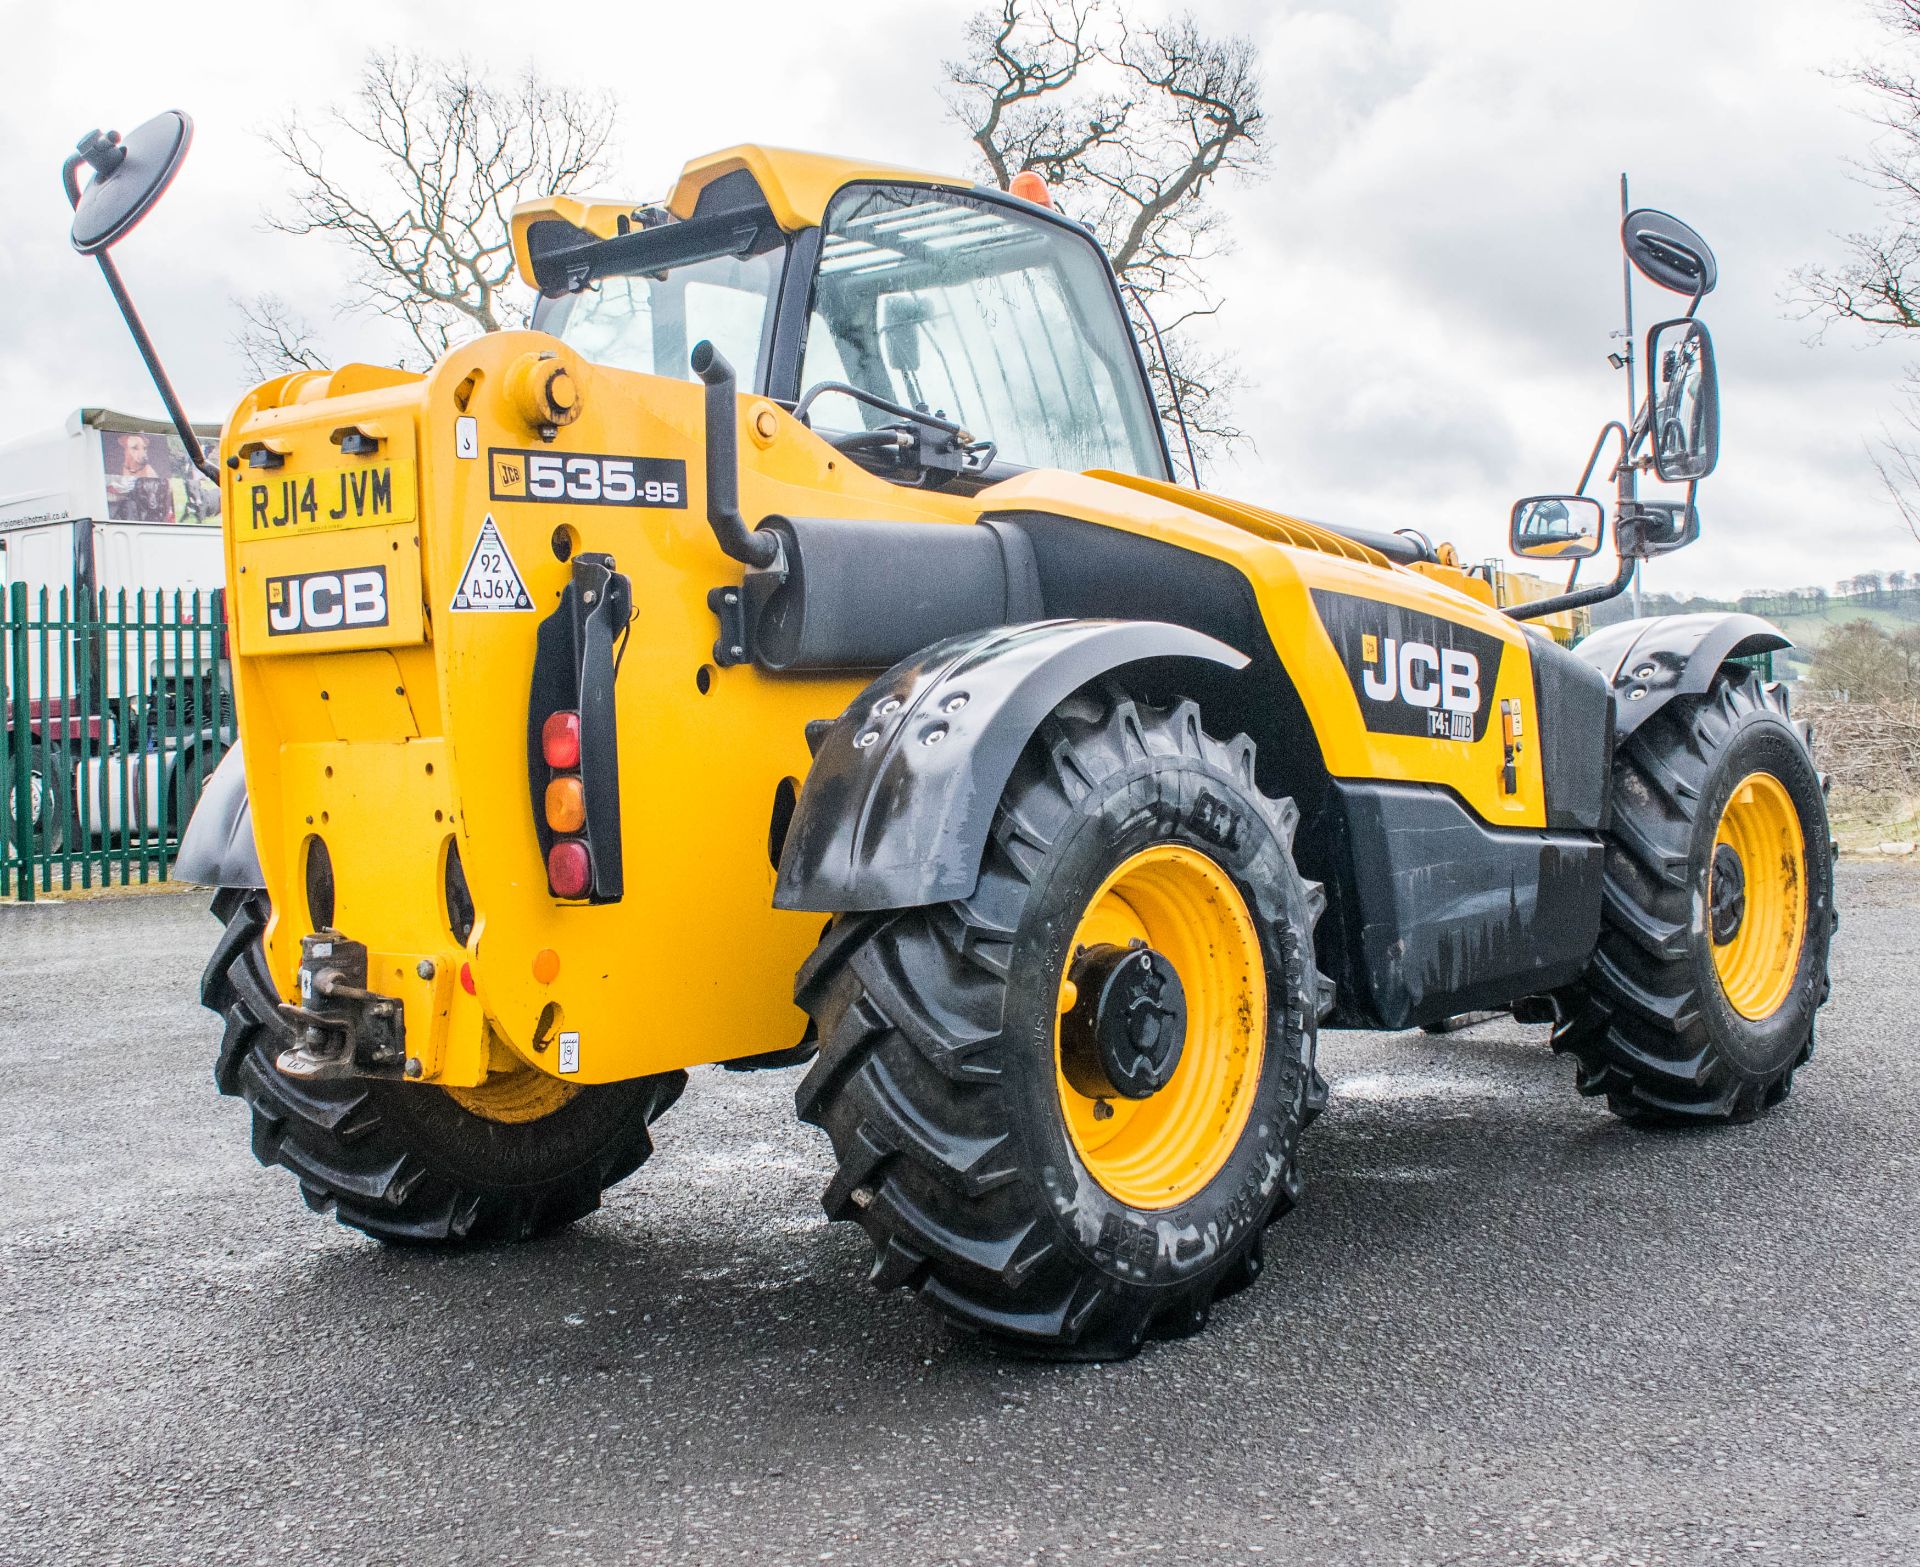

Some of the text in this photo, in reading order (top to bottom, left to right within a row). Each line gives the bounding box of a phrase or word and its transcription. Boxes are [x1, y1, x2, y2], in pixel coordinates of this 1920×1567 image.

[251, 467, 393, 530] RJ14 JVM
[502, 456, 680, 503] JCB 535-95
[481, 554, 501, 574] 92
[269, 571, 387, 631] JCB
[472, 579, 515, 600] AJ6X
[1363, 638, 1481, 713] JCB
[1429, 710, 1451, 737] T4i
